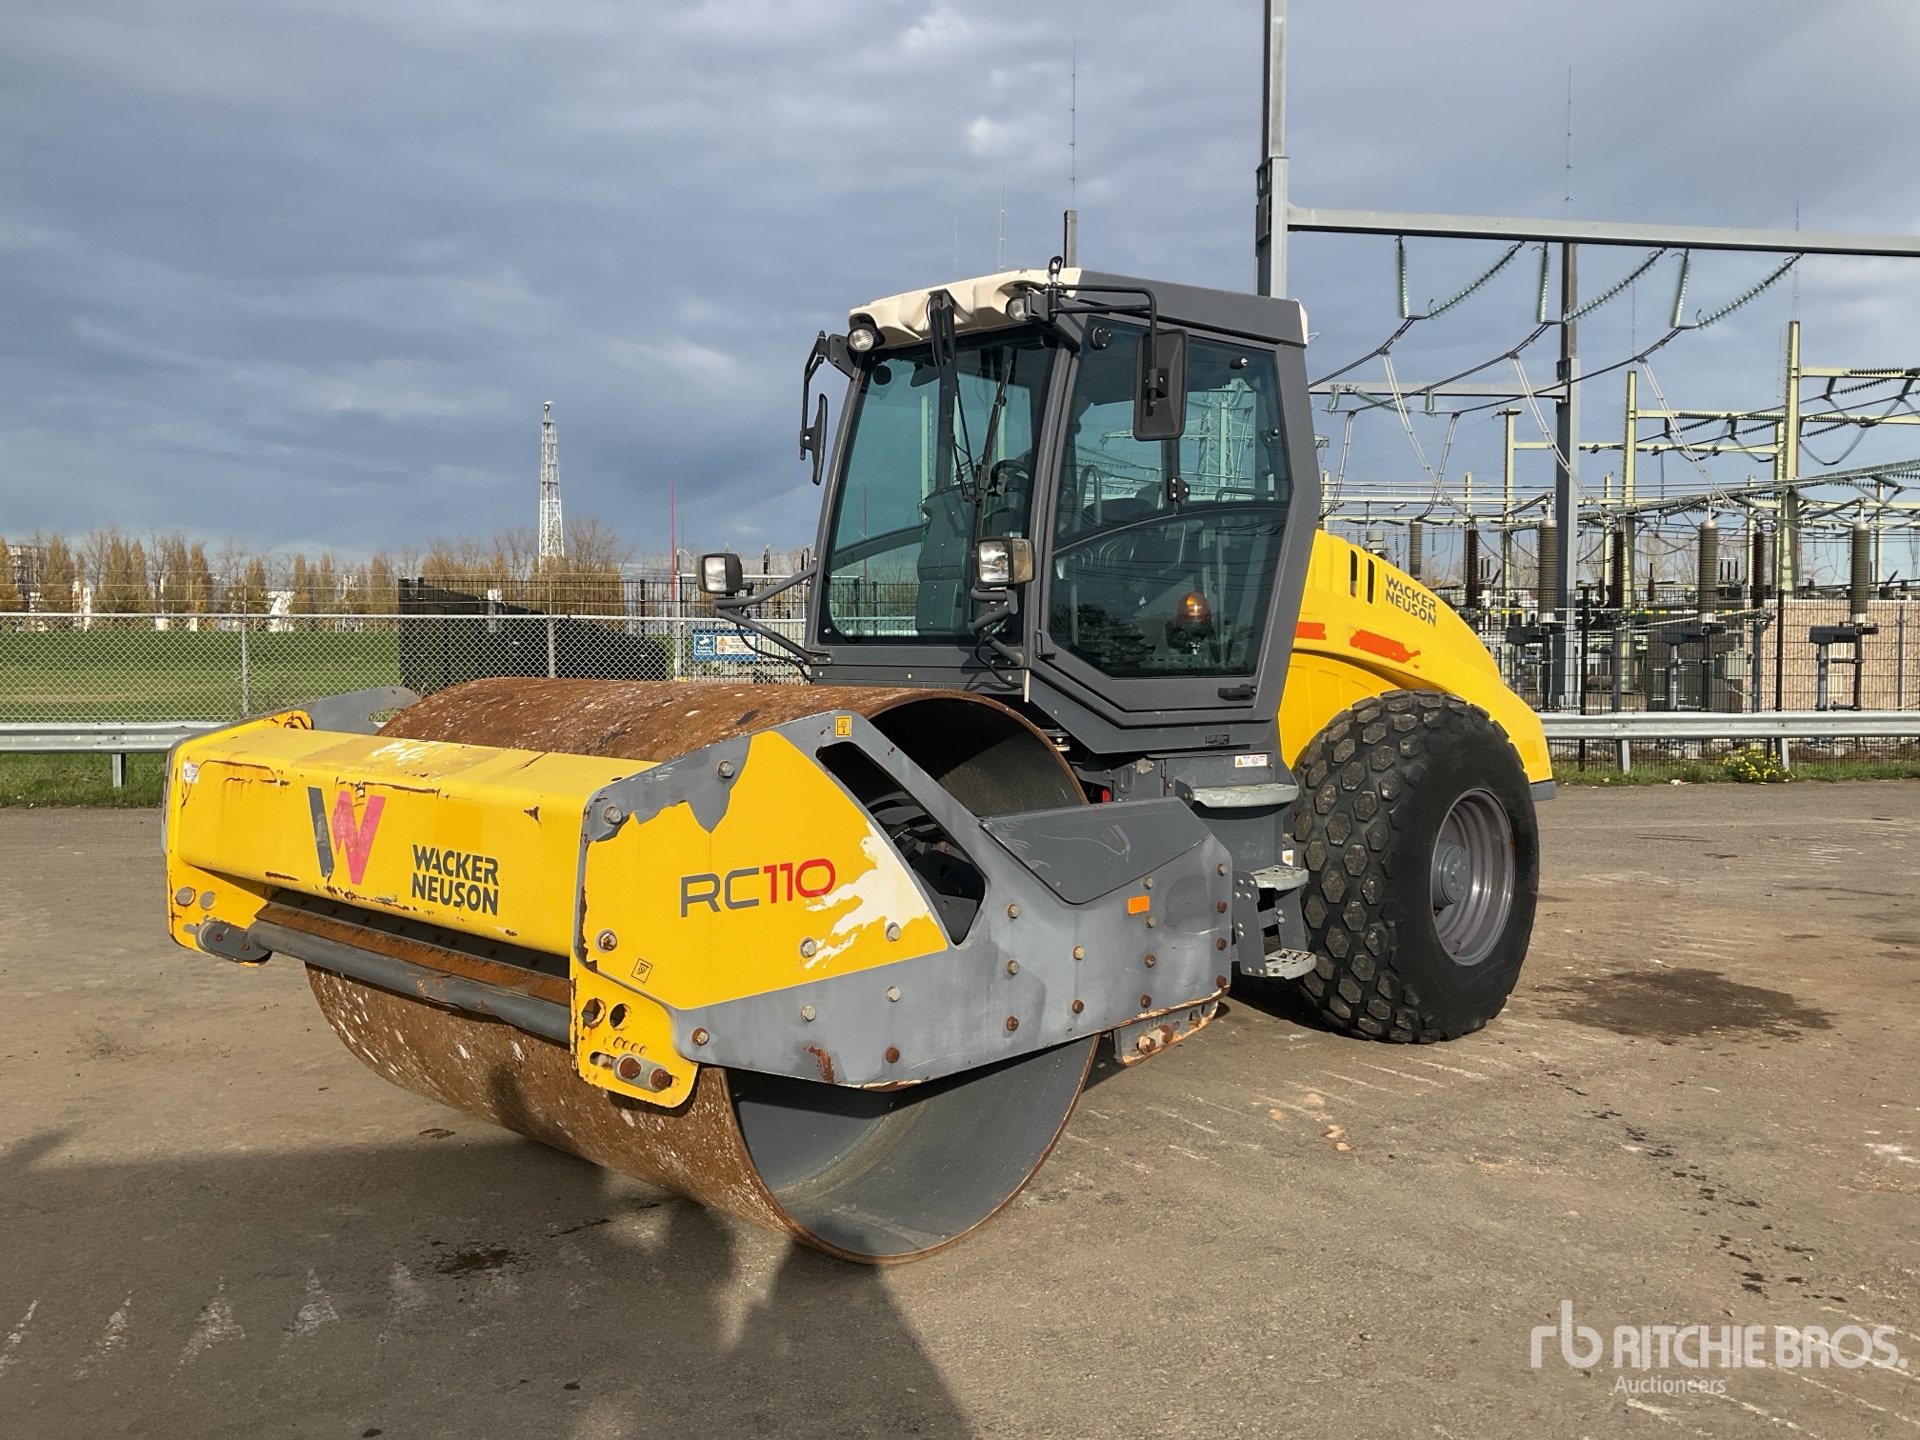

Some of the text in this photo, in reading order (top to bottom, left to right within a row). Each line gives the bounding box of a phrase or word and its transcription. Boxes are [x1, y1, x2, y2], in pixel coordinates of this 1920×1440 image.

[1385, 573, 1437, 614] WACKER
[1385, 588, 1437, 627] NEUSON
[412, 844, 499, 886] WACKER
[411, 872, 499, 916] NEUSON
[680, 858, 836, 918] RC110
